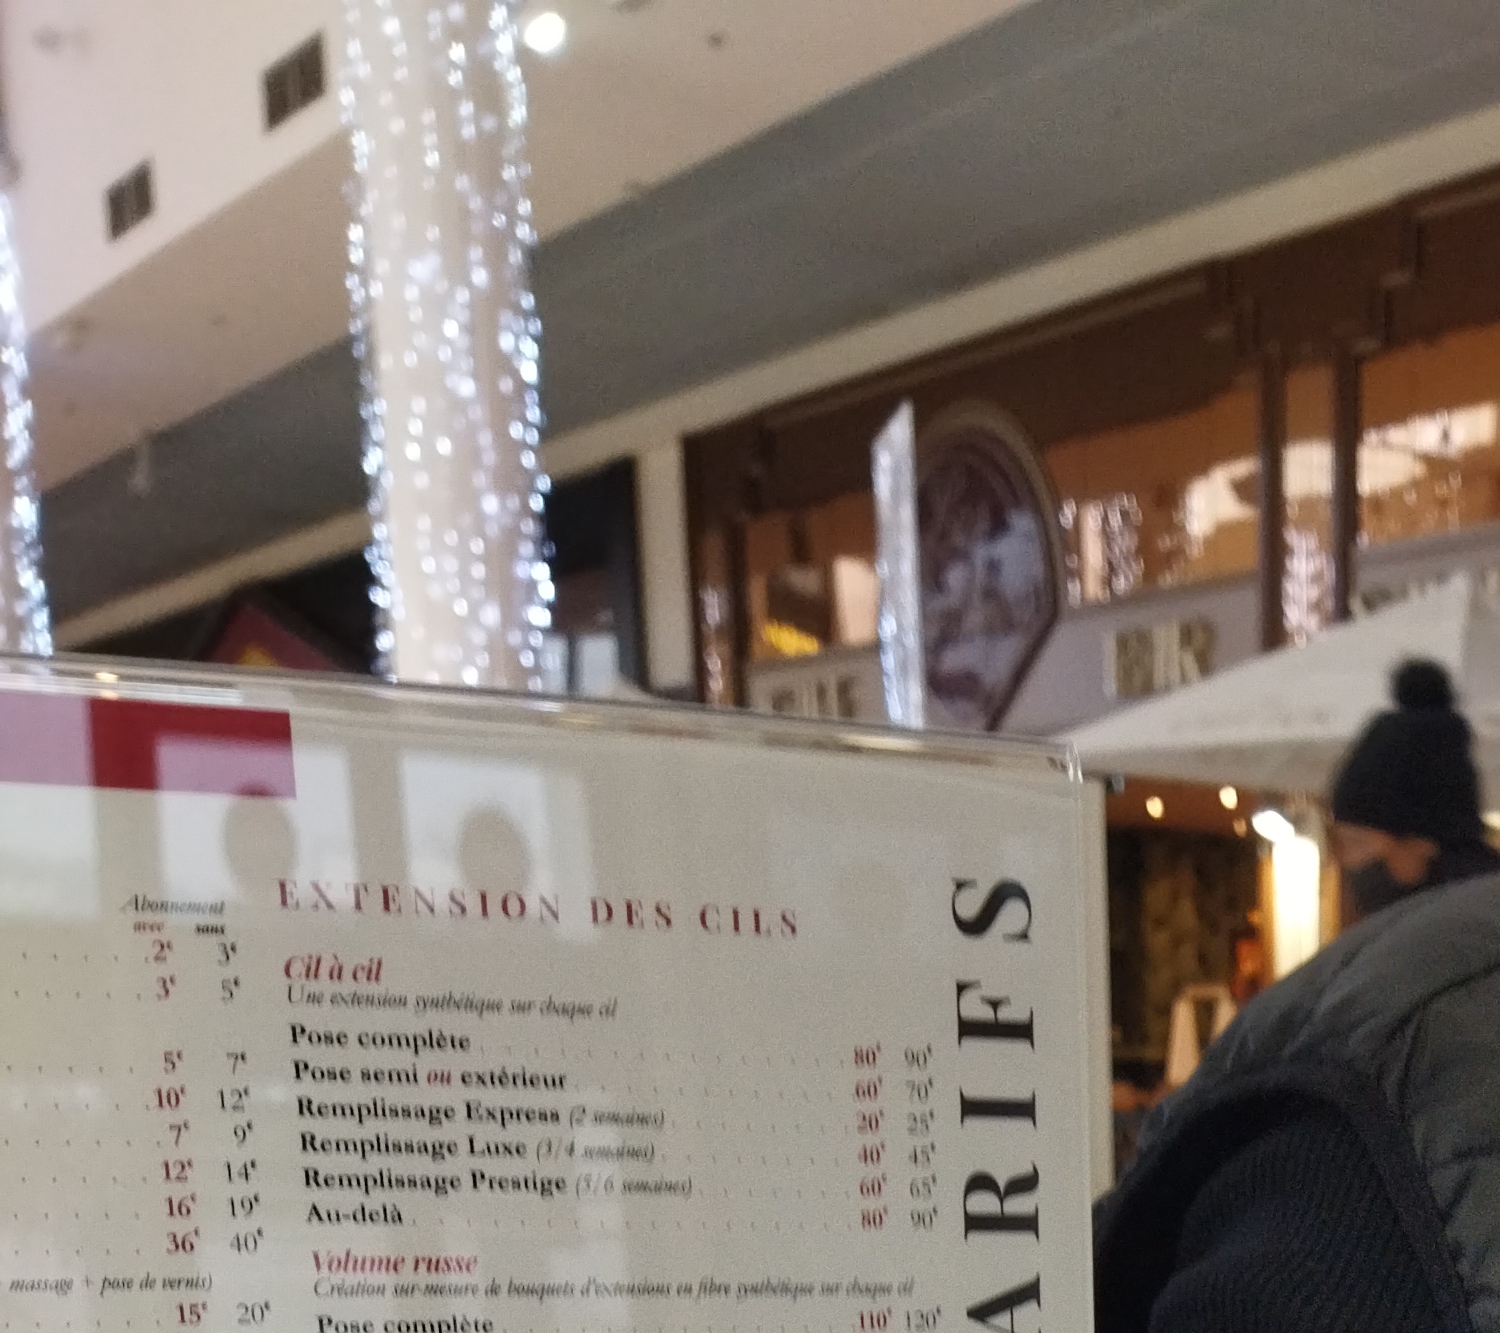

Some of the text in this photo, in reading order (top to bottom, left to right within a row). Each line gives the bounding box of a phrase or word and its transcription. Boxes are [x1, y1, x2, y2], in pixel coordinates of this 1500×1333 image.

[123, 894, 225, 917] Abonnement
[279, 878, 797, 939] EXTENSION DES CILS
[195, 922, 225, 936] sans
[284, 953, 383, 984] Cil à cil
[287, 984, 617, 1023] Une extension synthétique sur chaque cil
[290, 1023, 471, 1058] Pose complète
[293, 1059, 567, 1092] Pose semi ou extérieur
[297, 1096, 560, 1129] Remplissage Express
[300, 1132, 528, 1163] Remplissage Luxe
[302, 1167, 567, 1200] Remplissage Prestige
[306, 1202, 403, 1226] Au-delà
[312, 1248, 478, 1277] Volume russe
[9, 1271, 213, 1298] massage pose de vernis)
